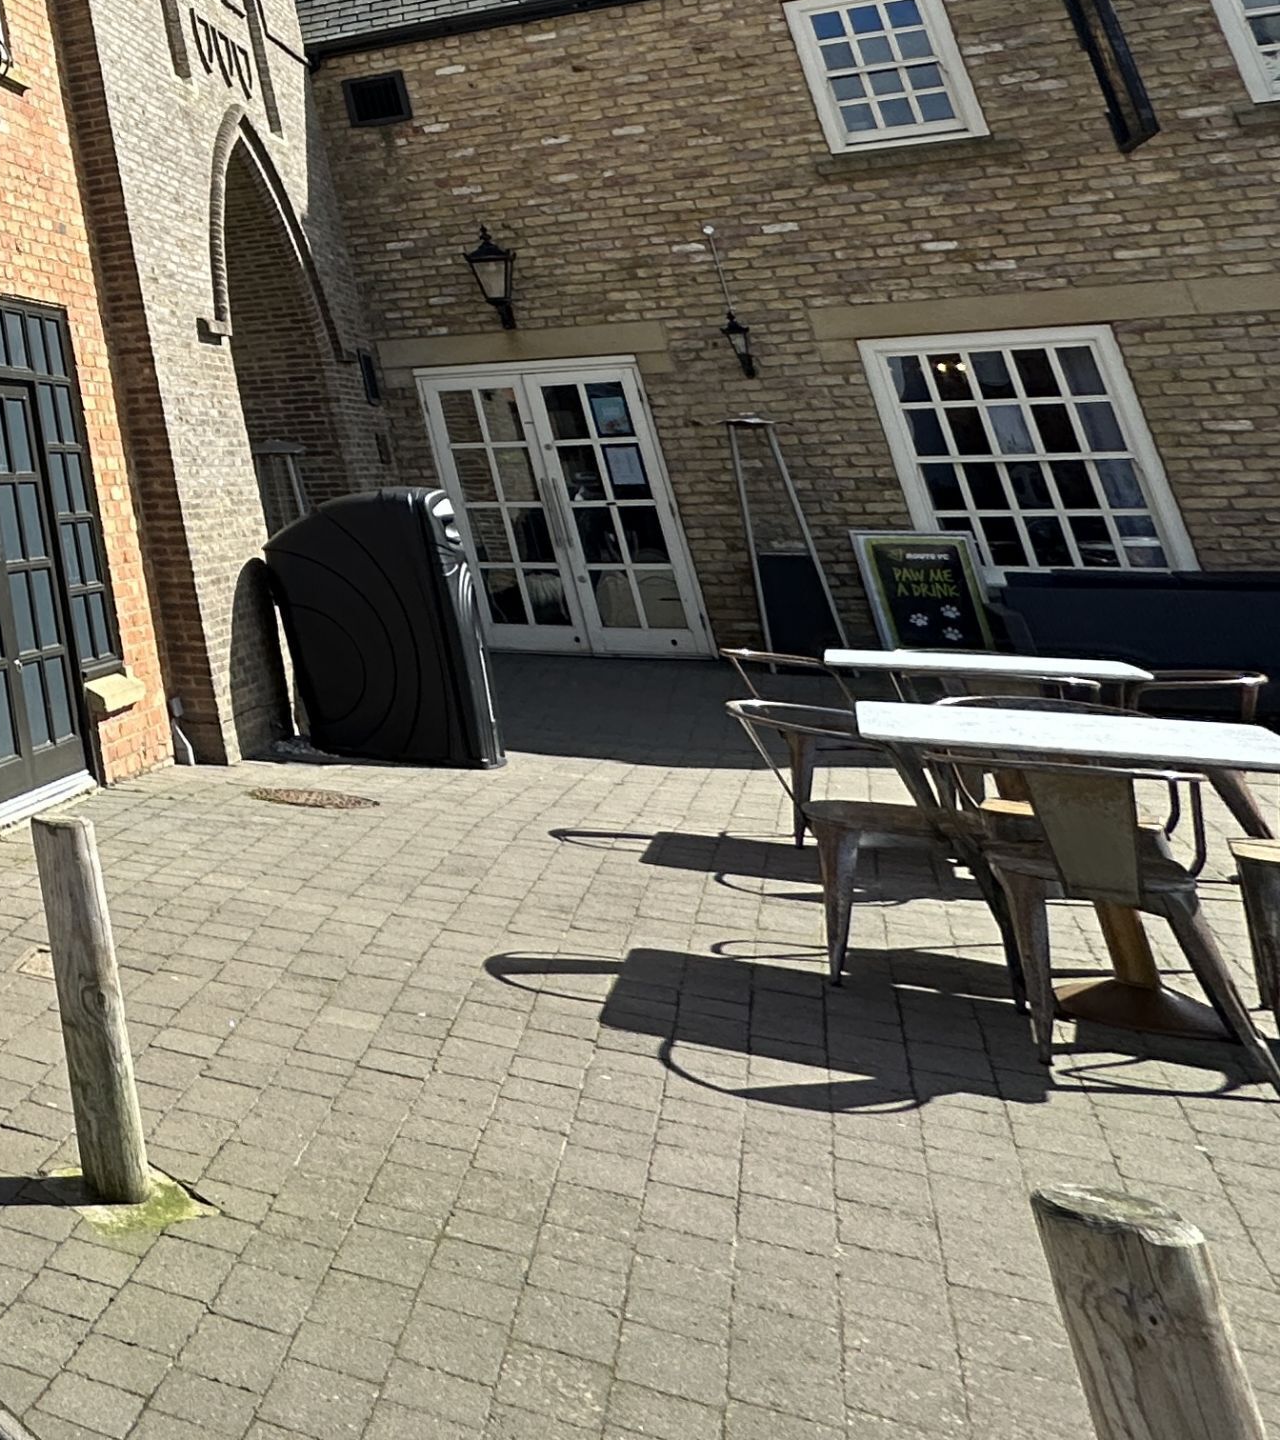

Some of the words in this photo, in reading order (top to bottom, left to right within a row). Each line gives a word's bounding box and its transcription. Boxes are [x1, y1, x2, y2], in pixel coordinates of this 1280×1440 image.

[892, 567, 925, 582] PAW
[929, 568, 954, 582] ME
[897, 582, 910, 597] A
[911, 581, 960, 598] DRINK
